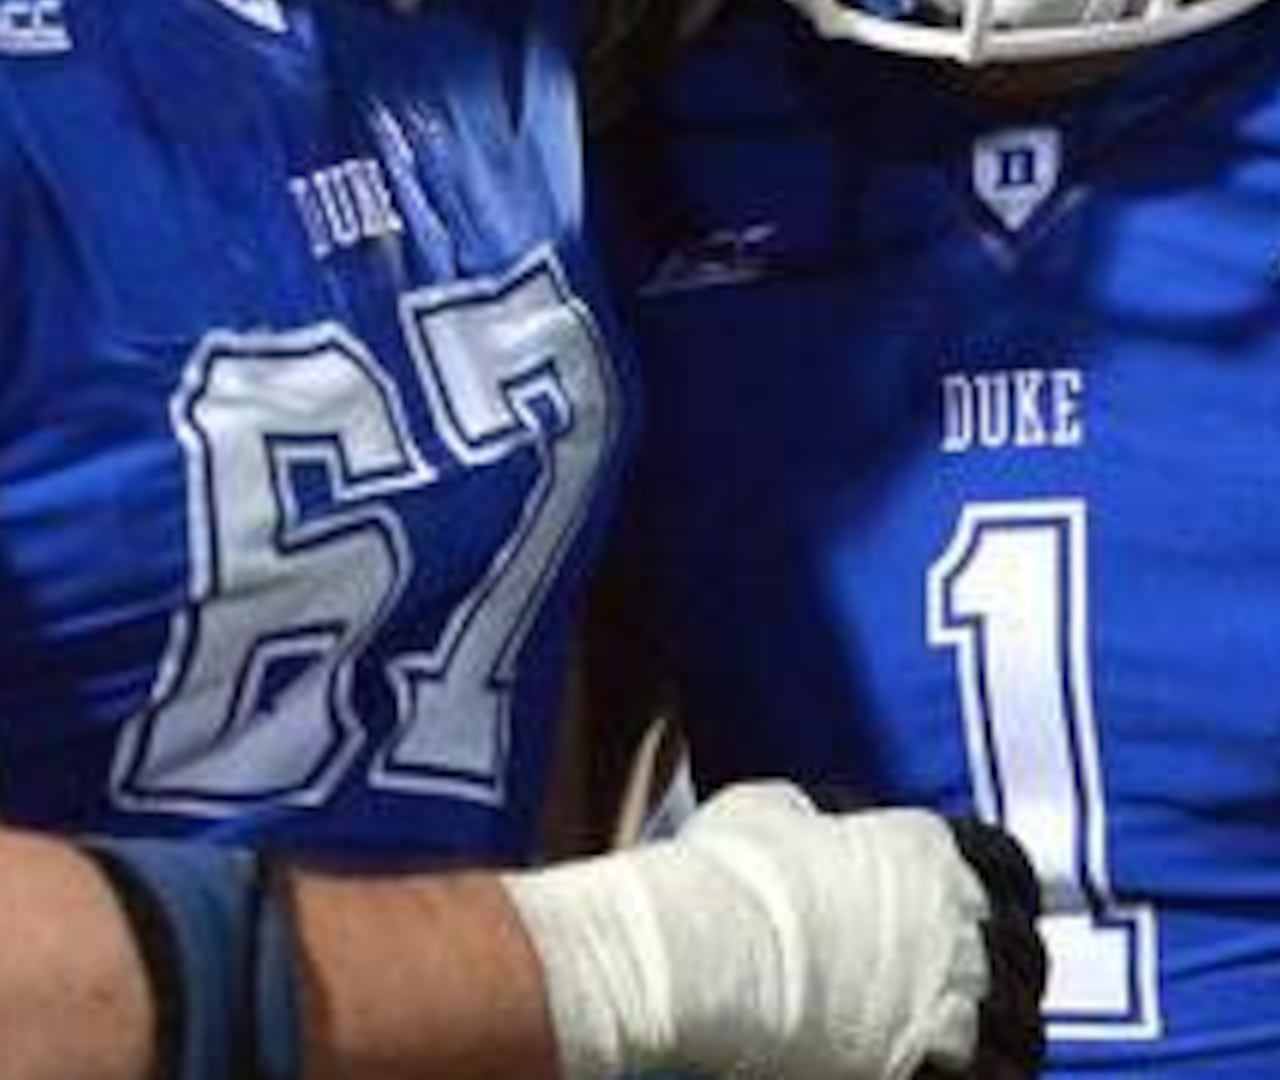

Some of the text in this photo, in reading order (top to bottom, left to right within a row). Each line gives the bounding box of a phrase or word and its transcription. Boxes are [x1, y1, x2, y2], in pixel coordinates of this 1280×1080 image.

[109, 242, 622, 815] 67
[941, 368, 1083, 454] DUKE
[926, 497, 1165, 1041] 1
